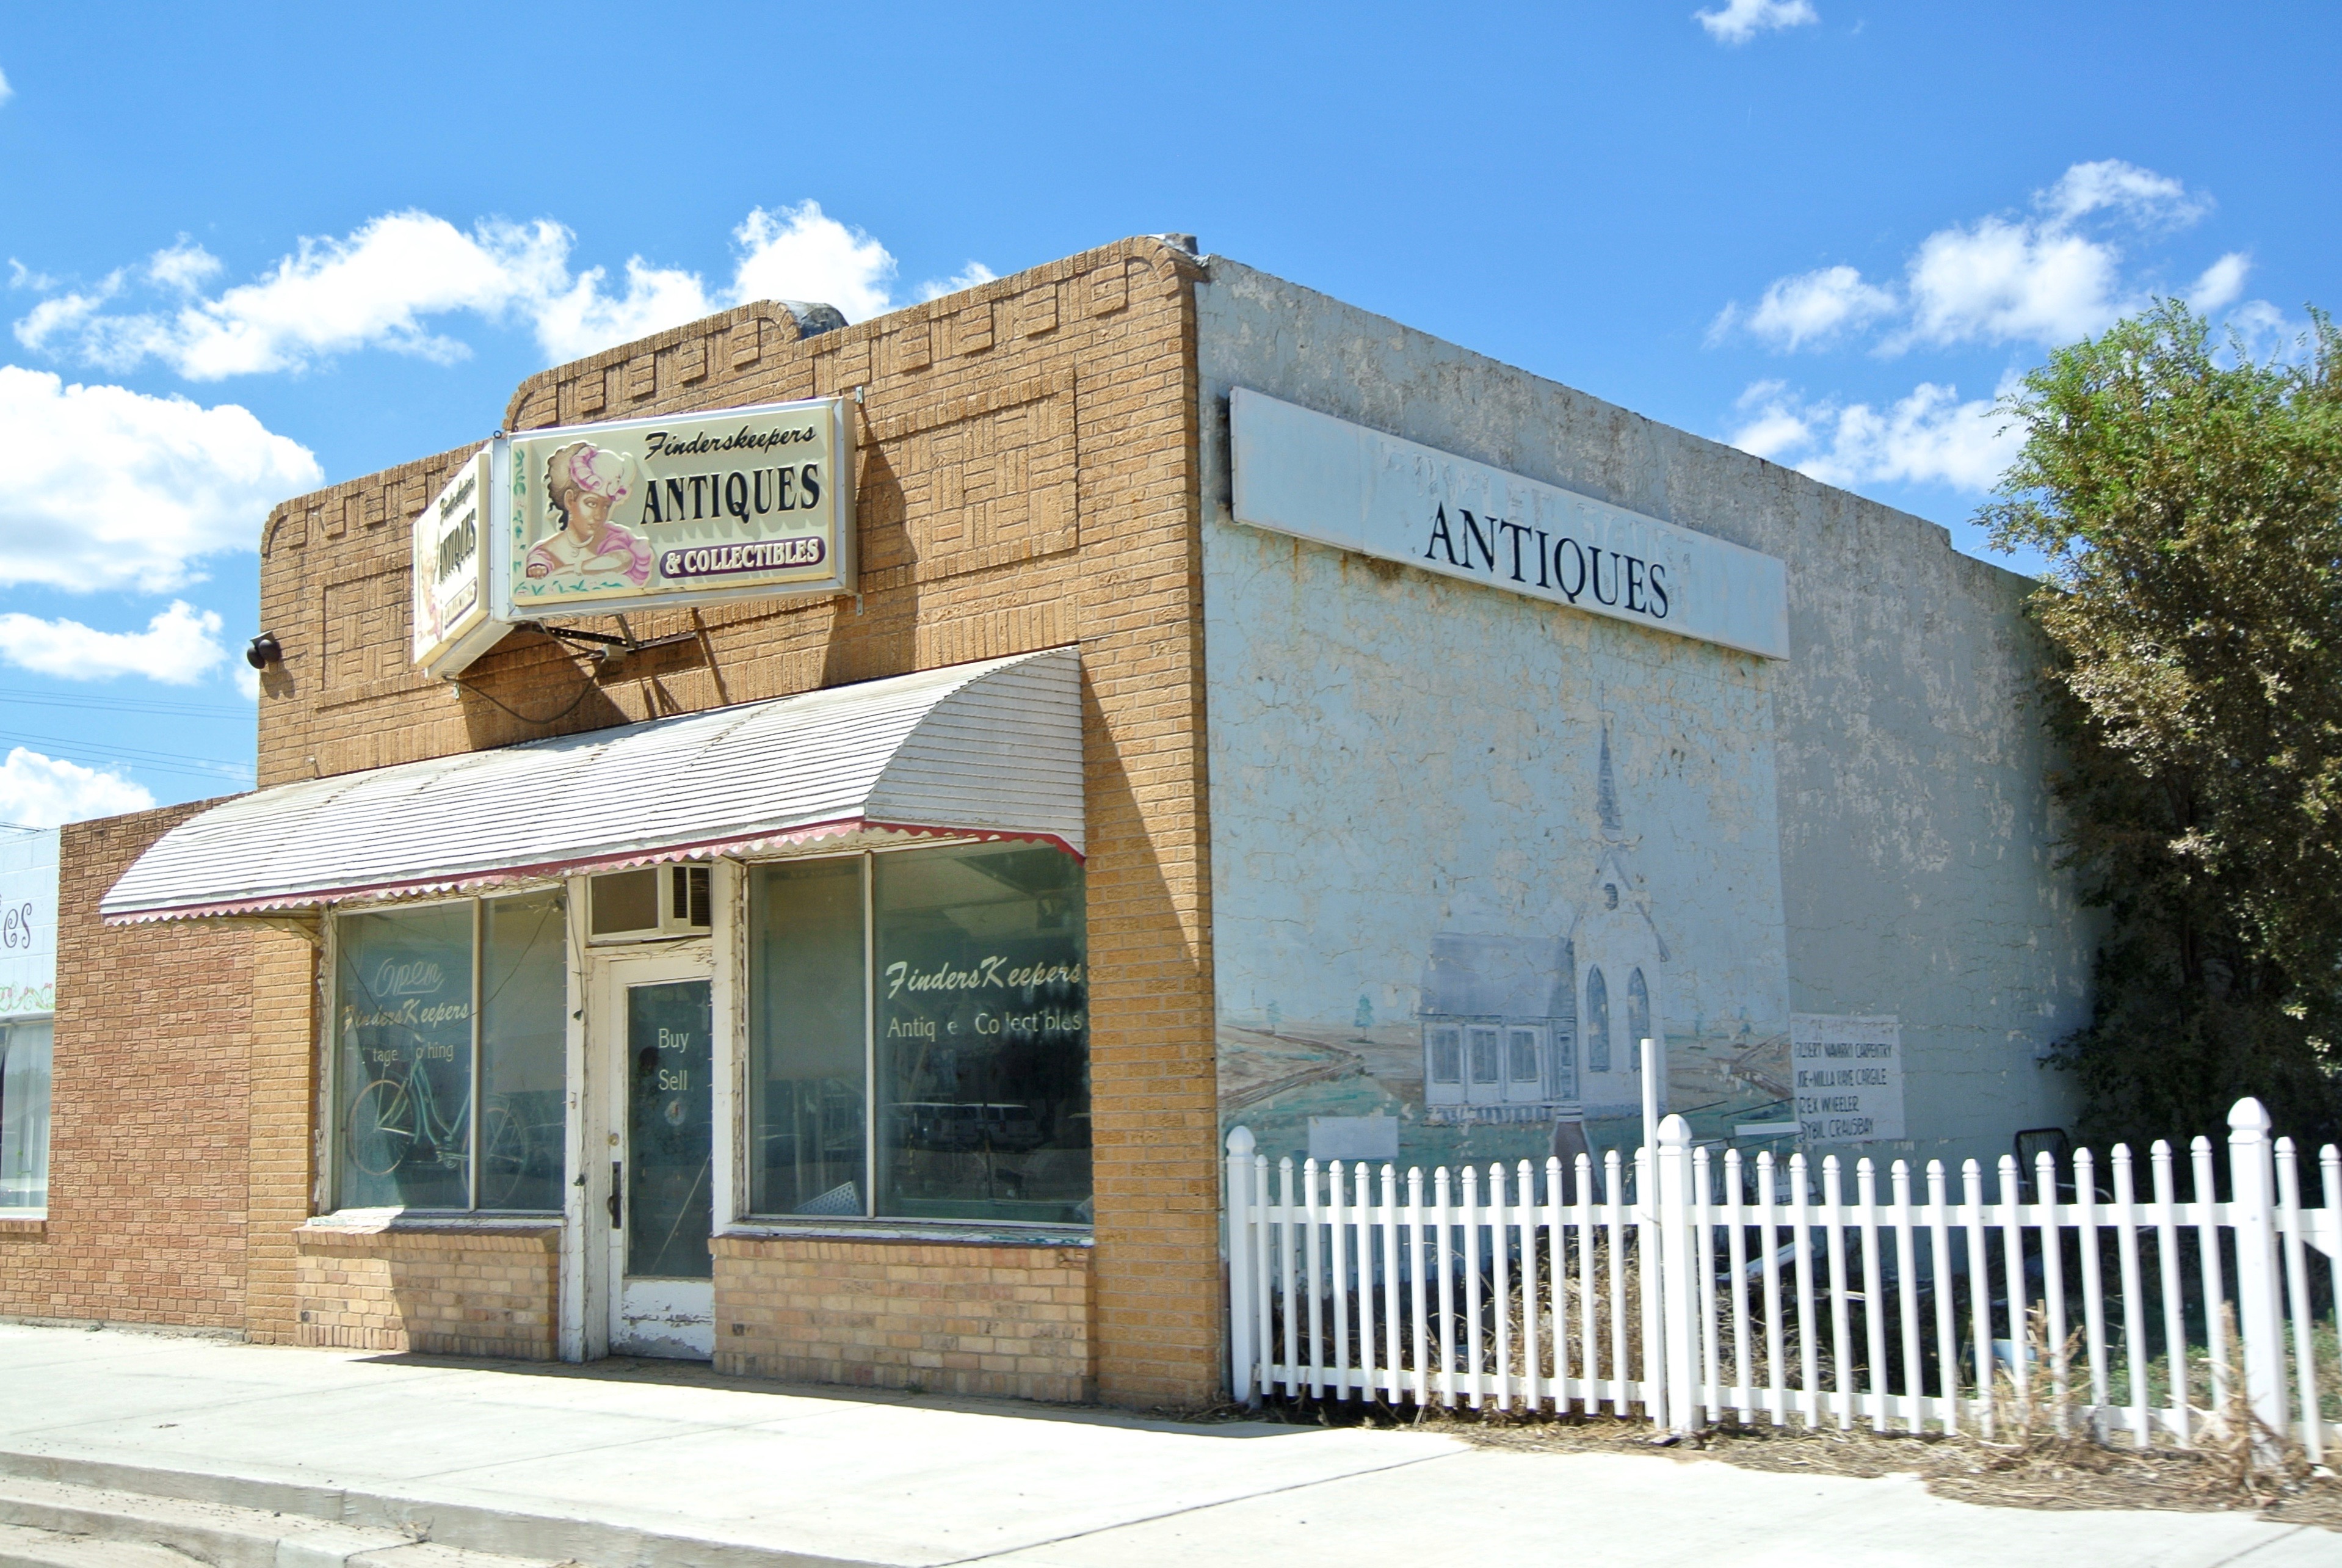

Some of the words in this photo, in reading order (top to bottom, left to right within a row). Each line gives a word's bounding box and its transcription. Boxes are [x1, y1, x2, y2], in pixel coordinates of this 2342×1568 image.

[644, 425, 816, 460] Finderskeepers
[640, 463, 821, 525] ANTIQUES
[665, 552, 682, 573] &
[684, 538, 820, 573] COLLECTIBLES
[1424, 501, 1668, 619] ANTIQUES
[374, 957, 446, 997] Open
[658, 1028, 689, 1053] Buy
[658, 1069, 688, 1091] Sell
[1799, 1096, 1819, 1114] REX
[1821, 1095, 1860, 1112] WHEELER
